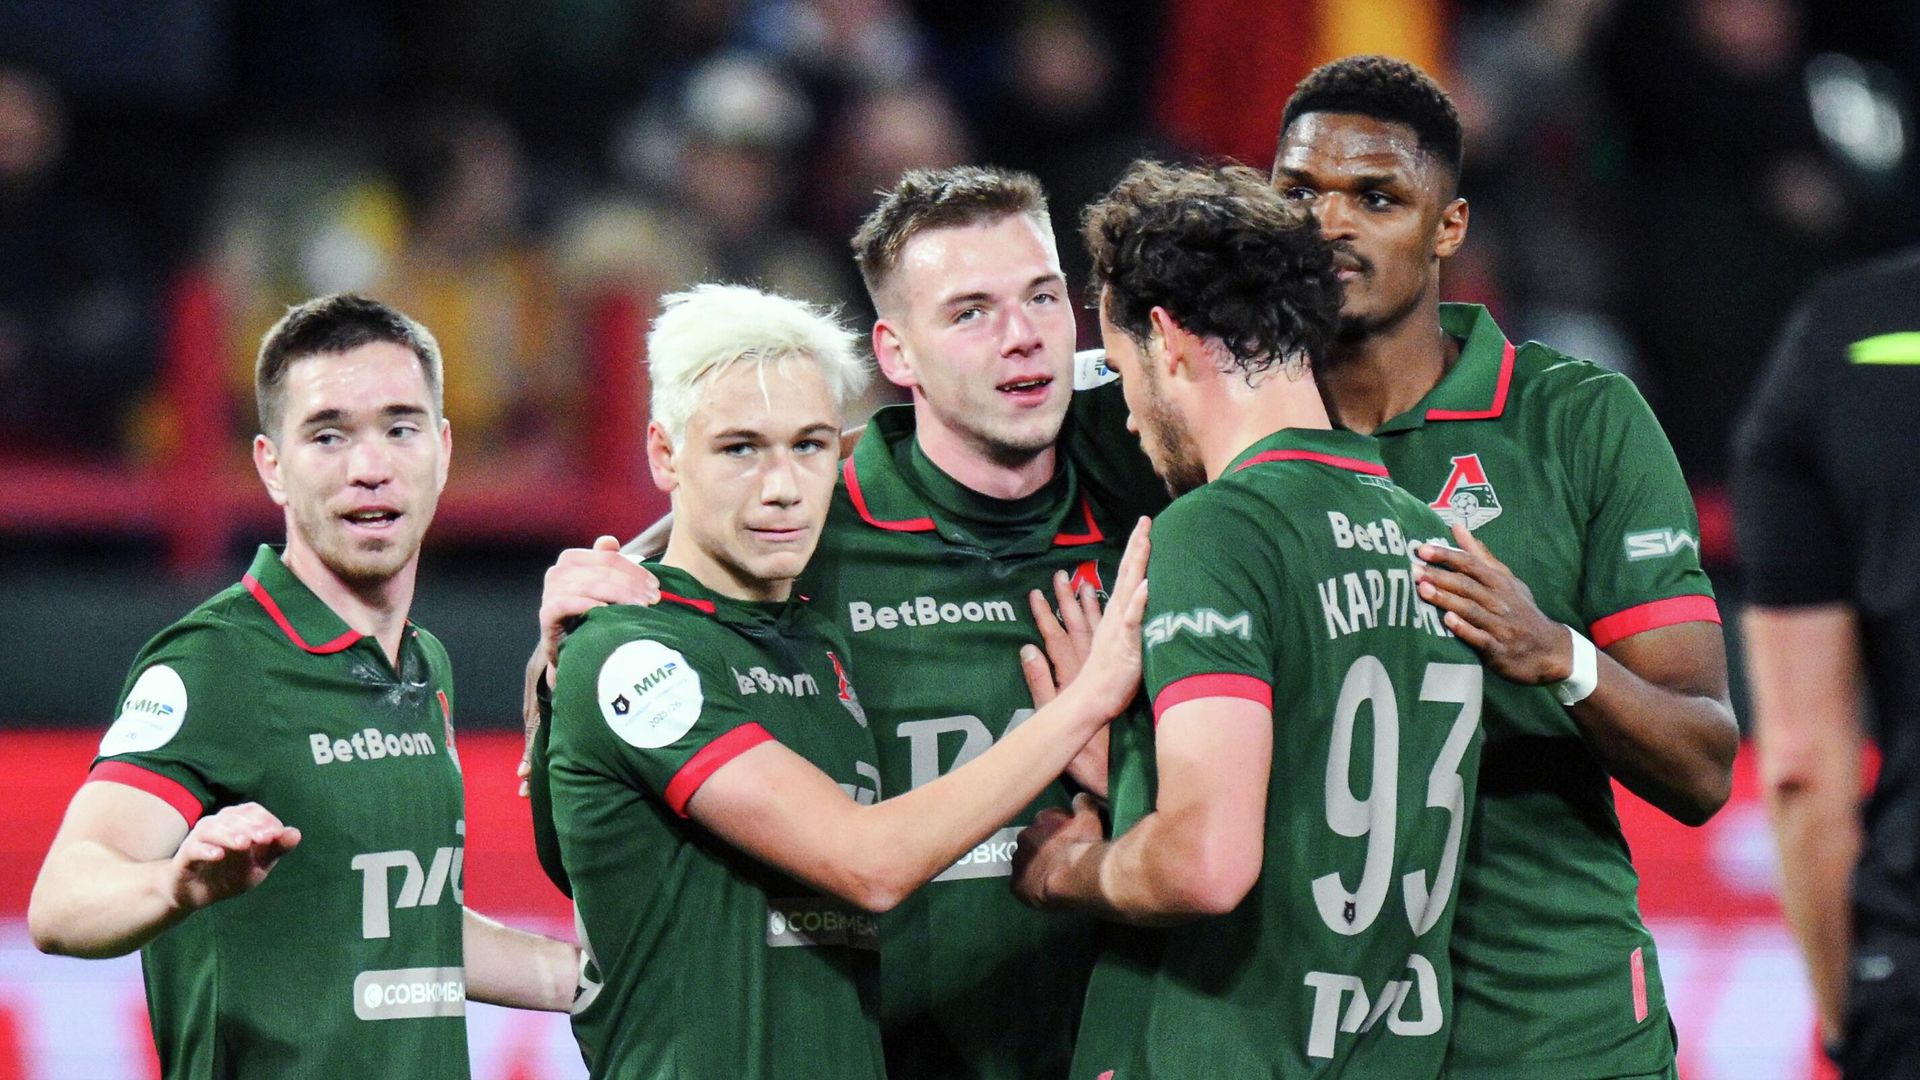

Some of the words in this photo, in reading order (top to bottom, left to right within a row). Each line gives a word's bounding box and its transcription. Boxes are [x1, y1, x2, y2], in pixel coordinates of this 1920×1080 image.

[849, 596, 1017, 632] BetBoom
[1144, 609, 1251, 650] SWM
[633, 662, 678, 697] МИР
[309, 728, 437, 765] BetBoom
[1312, 655, 1484, 937] 93
